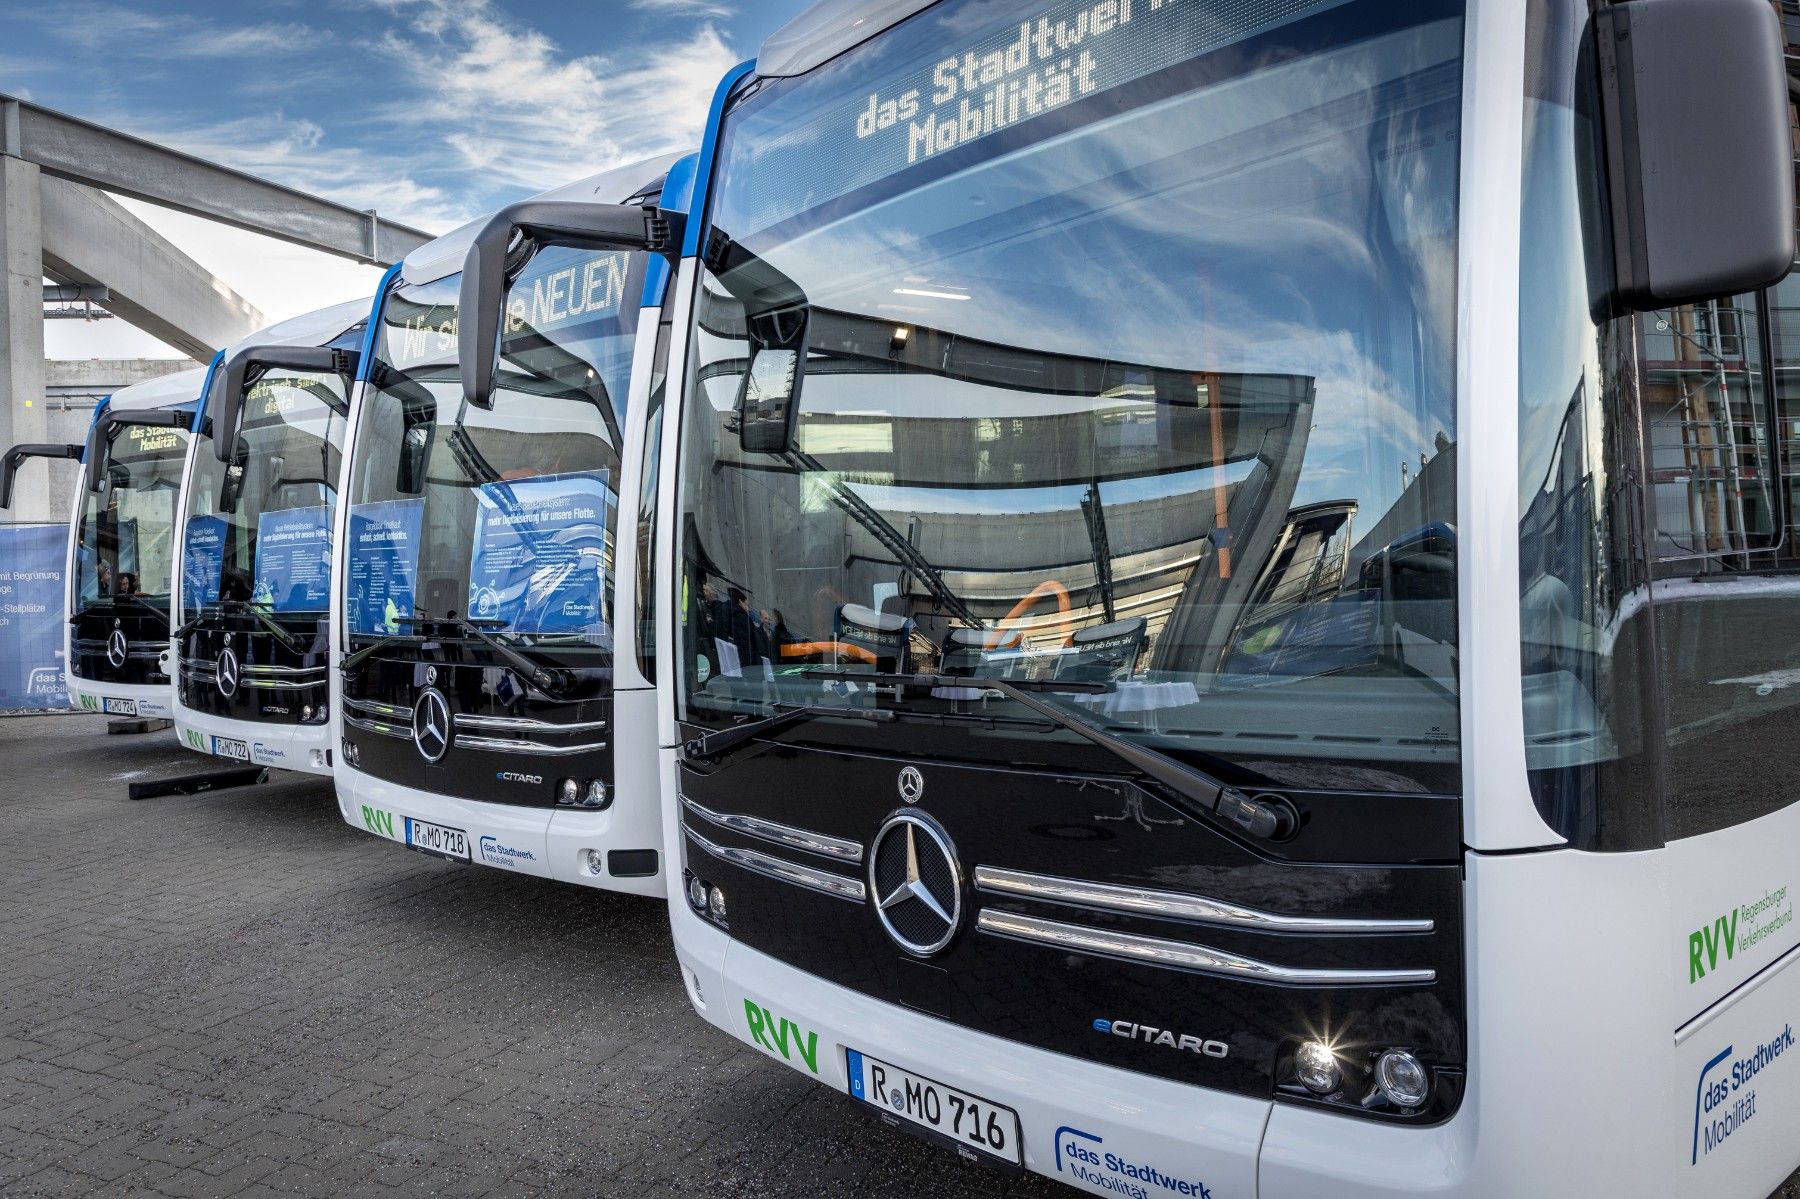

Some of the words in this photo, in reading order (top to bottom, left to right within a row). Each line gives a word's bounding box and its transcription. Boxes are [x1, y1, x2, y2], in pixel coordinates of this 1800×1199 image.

[856, 88, 920, 138] das
[933, 0, 1162, 105] Stadtwer
[908, 51, 1096, 164] Mobilität
[531, 251, 631, 327] NEUEN
[130, 427, 145, 439] das
[140, 434, 177, 451] Mobilität
[540, 510, 550, 521] für
[550, 510, 573, 521] unsere
[573, 507, 596, 520] Flotte.
[13, 571, 60, 582] Begrünung
[36, 673, 56, 682] das
[36, 685, 67, 694] Mobil
[187, 728, 206, 750] RVV
[234, 742, 247, 759] 722
[496, 771, 543, 785] eCITARO
[362, 804, 395, 838] RVV
[414, 823, 421, 844] R
[427, 826, 441, 849] MO
[443, 830, 464, 854] 718
[484, 842, 497, 853] das
[1742, 886, 1787, 924] Regensburger
[1737, 901, 1793, 953] Verkehrsverbund
[1689, 908, 1738, 985] RVV
[744, 998, 819, 1075] RVV
[1092, 1018, 1229, 1059] eCITARO
[1704, 1078, 1729, 1114] das
[1732, 1023, 1796, 1091] Stadtwerk.
[855, 1079, 861, 1090] D
[871, 1064, 889, 1105] R
[905, 1077, 941, 1126] MO
[948, 1094, 1005, 1151] 716
[1704, 1090, 1756, 1155] Mobilität
[1066, 1141, 1100, 1166] das
[1104, 1153, 1213, 1199] Stadtwerk
[1070, 1163, 1149, 1199] Mobilität
